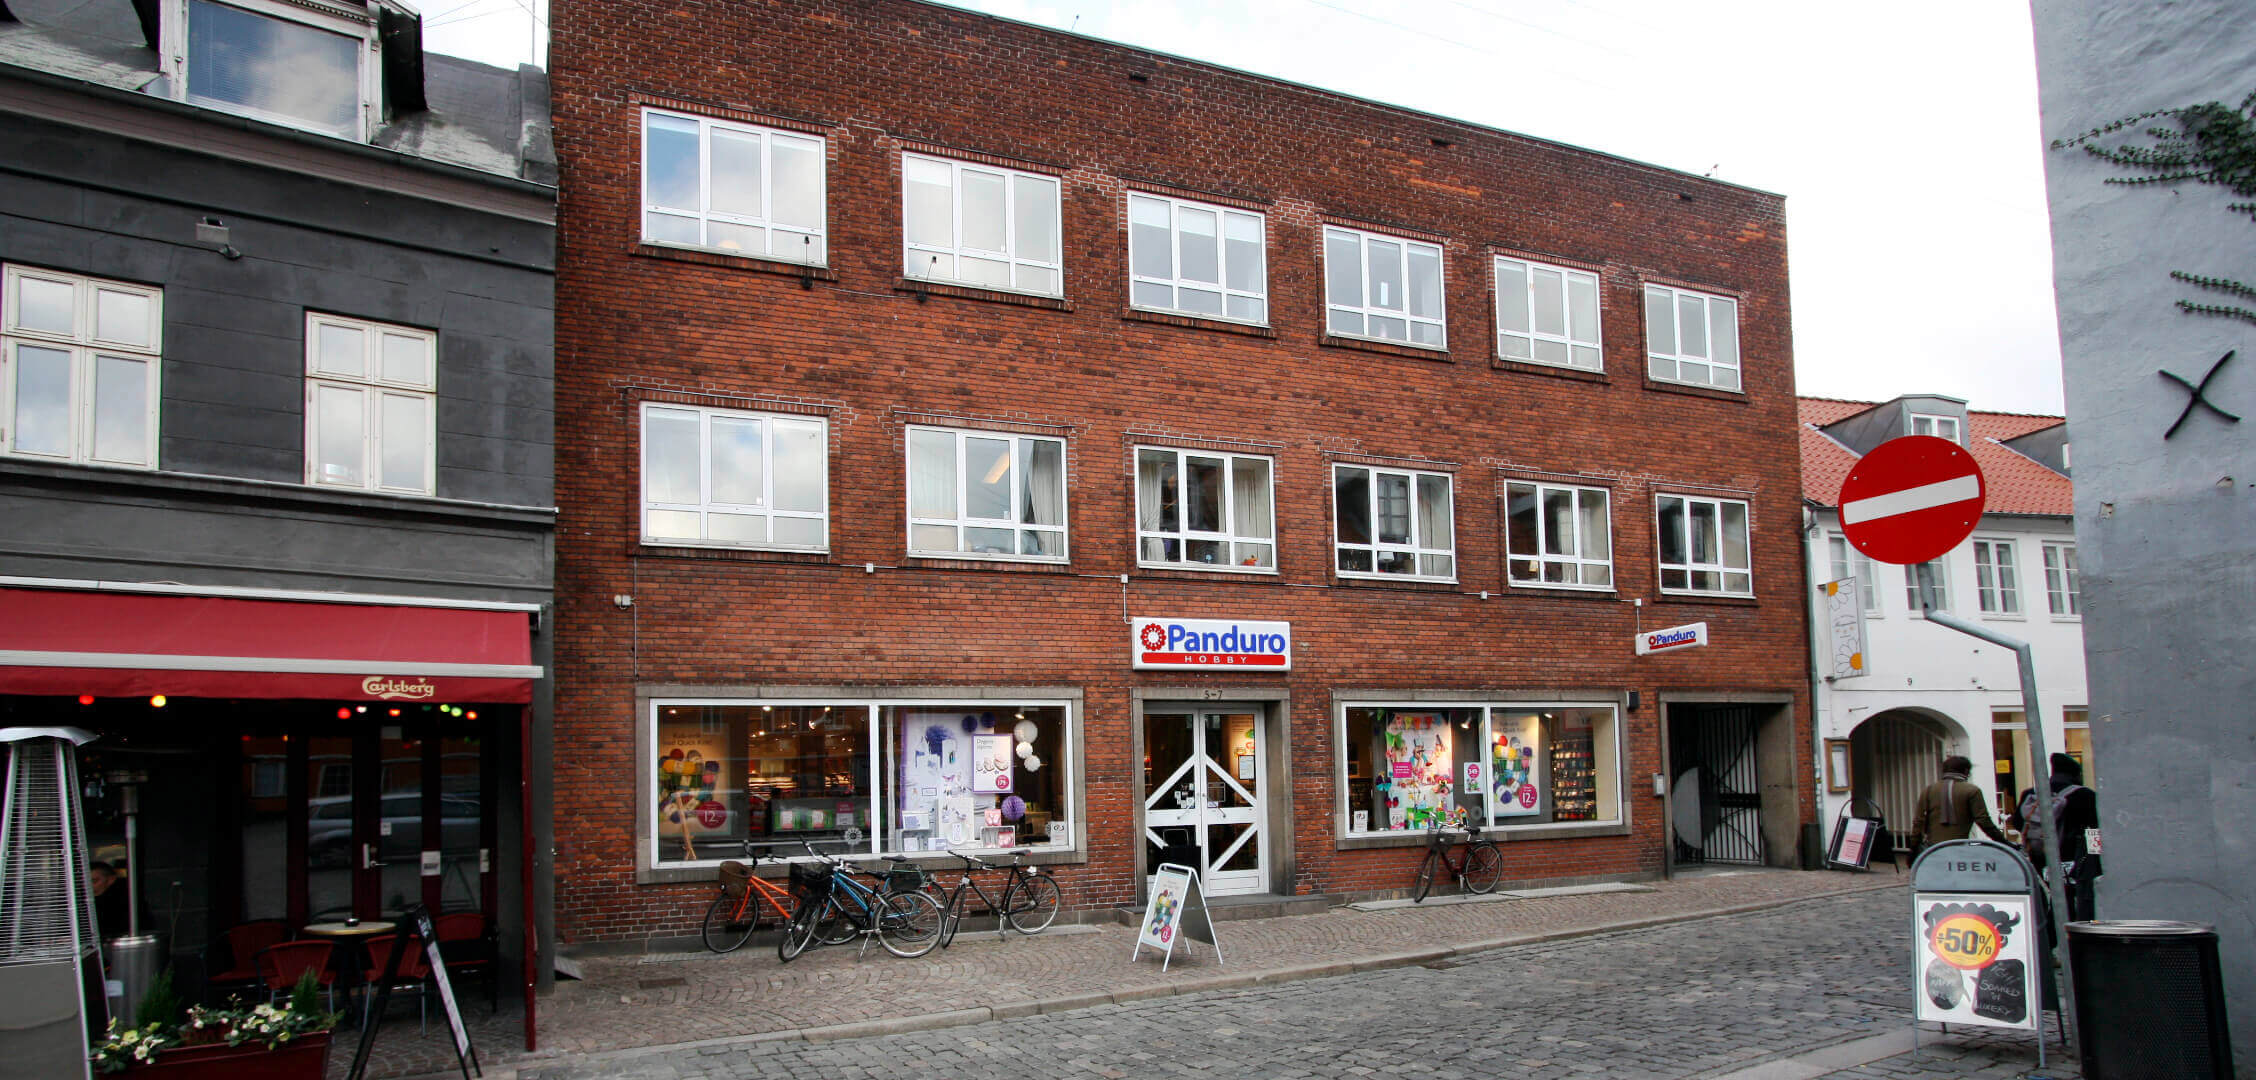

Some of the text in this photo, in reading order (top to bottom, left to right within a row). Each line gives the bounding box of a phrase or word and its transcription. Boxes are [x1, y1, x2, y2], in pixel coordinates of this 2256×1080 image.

[1168, 624, 1286, 653] Panduro
[1656, 630, 1696, 645] Panduro
[1184, 655, 1249, 664] HOBBY
[1907, 677, 1913, 686] 9
[362, 676, 434, 699] Carlsberg
[1204, 690, 1223, 700] 5-7
[1948, 862, 1997, 872] IBEN
